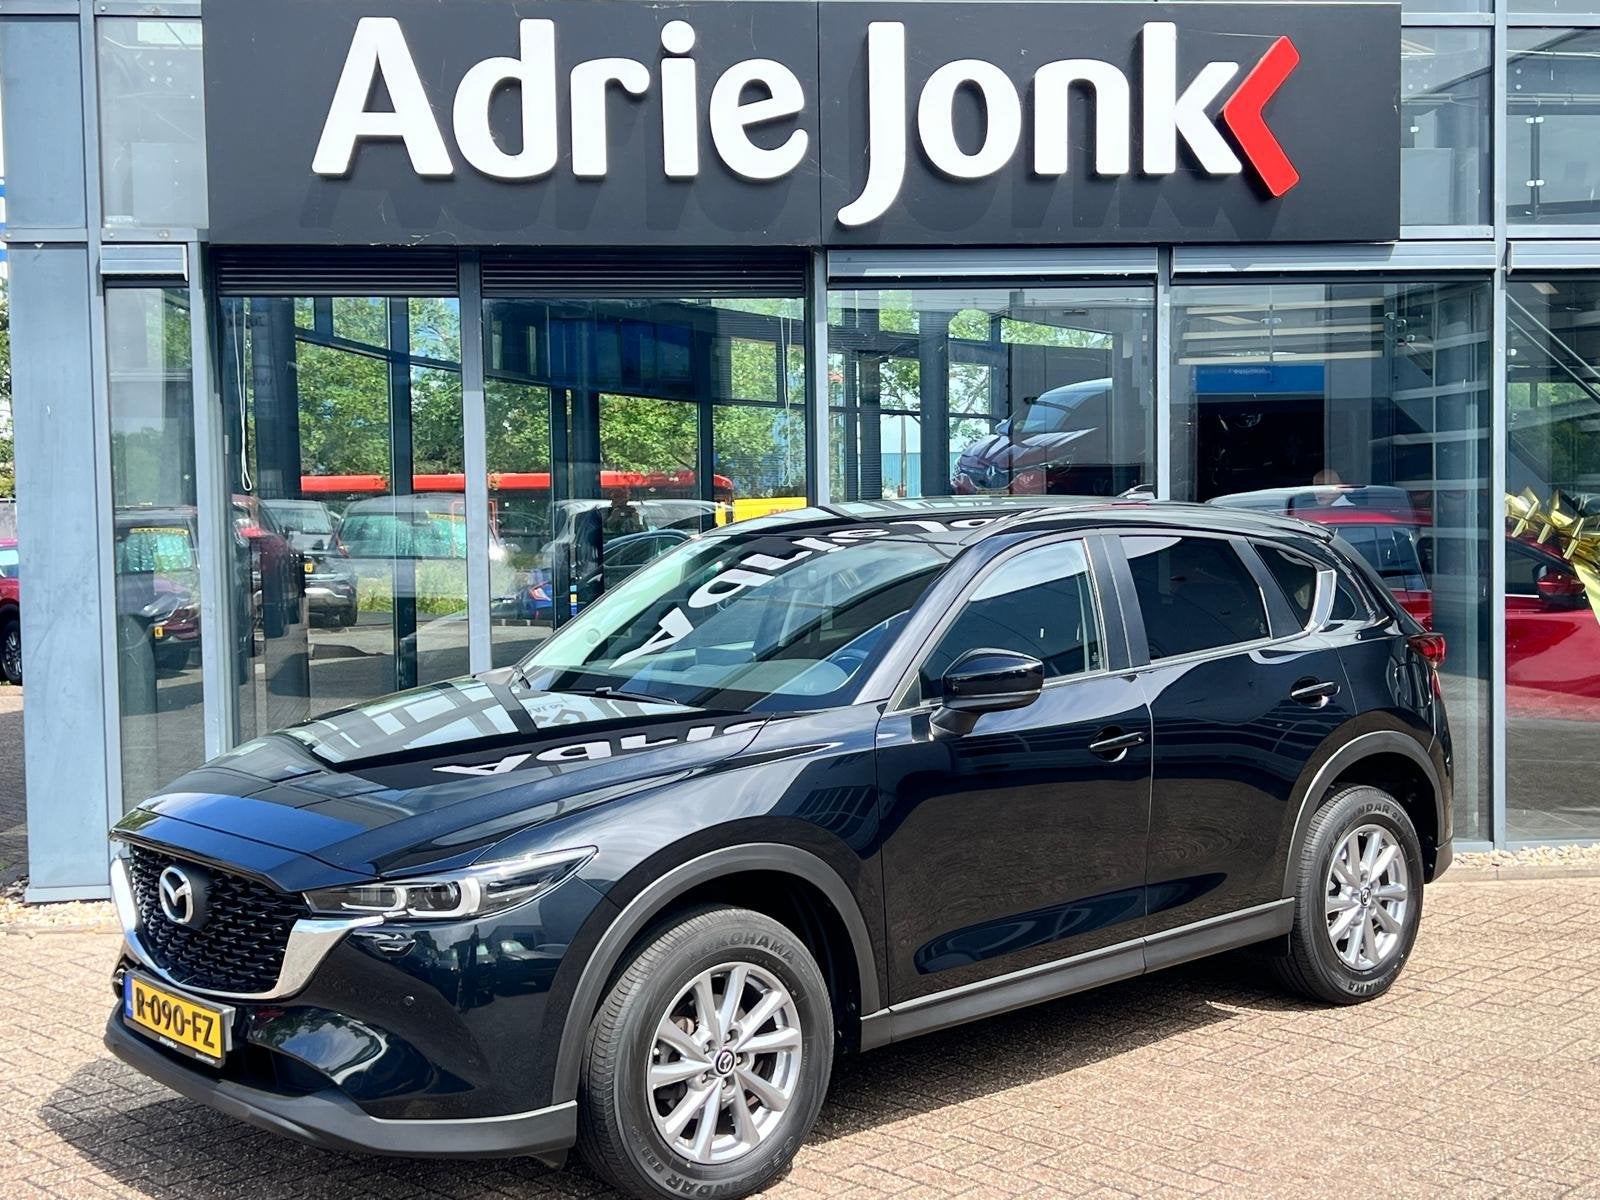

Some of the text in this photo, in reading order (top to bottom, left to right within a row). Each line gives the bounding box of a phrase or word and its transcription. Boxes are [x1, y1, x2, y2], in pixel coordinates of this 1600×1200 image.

[312, 16, 1244, 227] Adrie Jonk
[136, 987, 214, 1048] R-090-FZ
